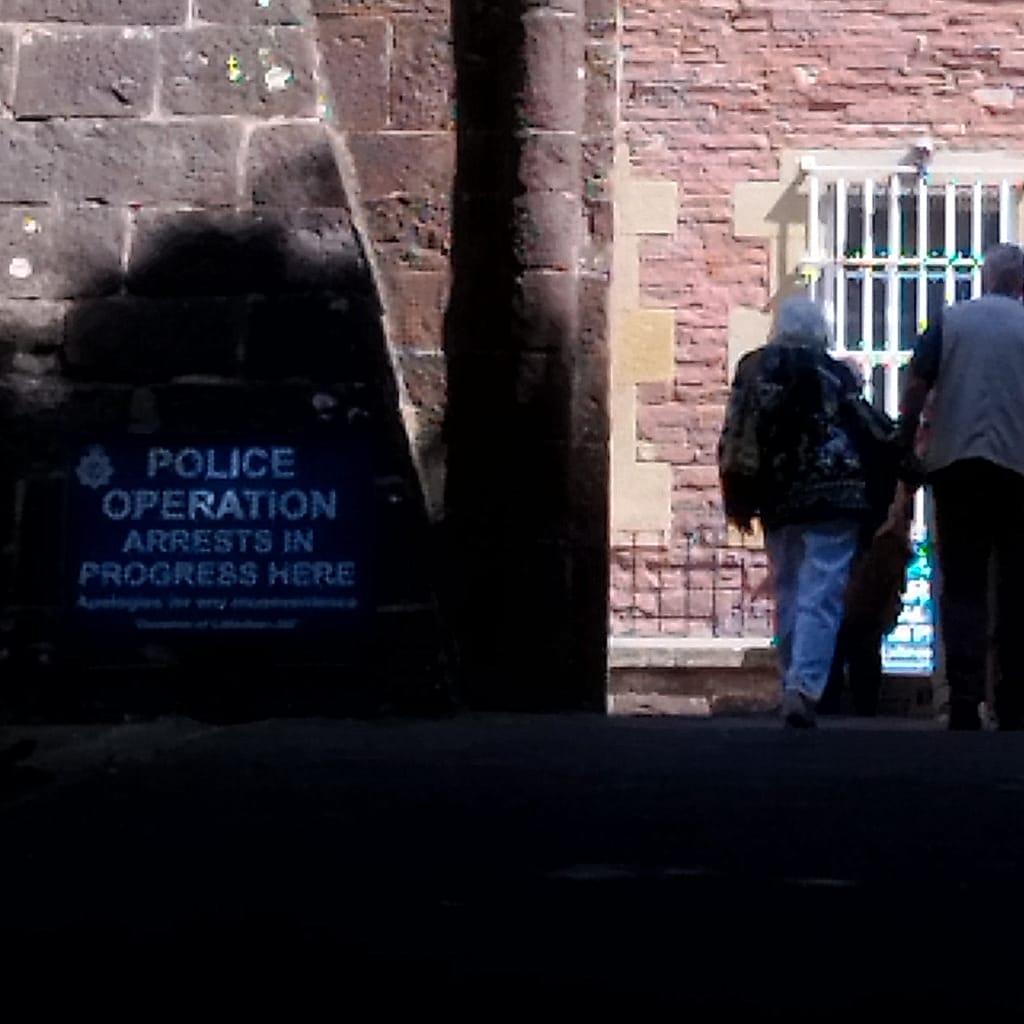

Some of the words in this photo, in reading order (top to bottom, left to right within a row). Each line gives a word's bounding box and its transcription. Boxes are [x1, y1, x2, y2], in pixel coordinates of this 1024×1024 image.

[147, 447, 295, 478] POLICE
[102, 488, 337, 520] OPERATION
[121, 529, 273, 553] ARRESTS
[283, 529, 315, 553] IN
[77, 561, 258, 587] PROGRESS
[268, 561, 356, 587] HERE
